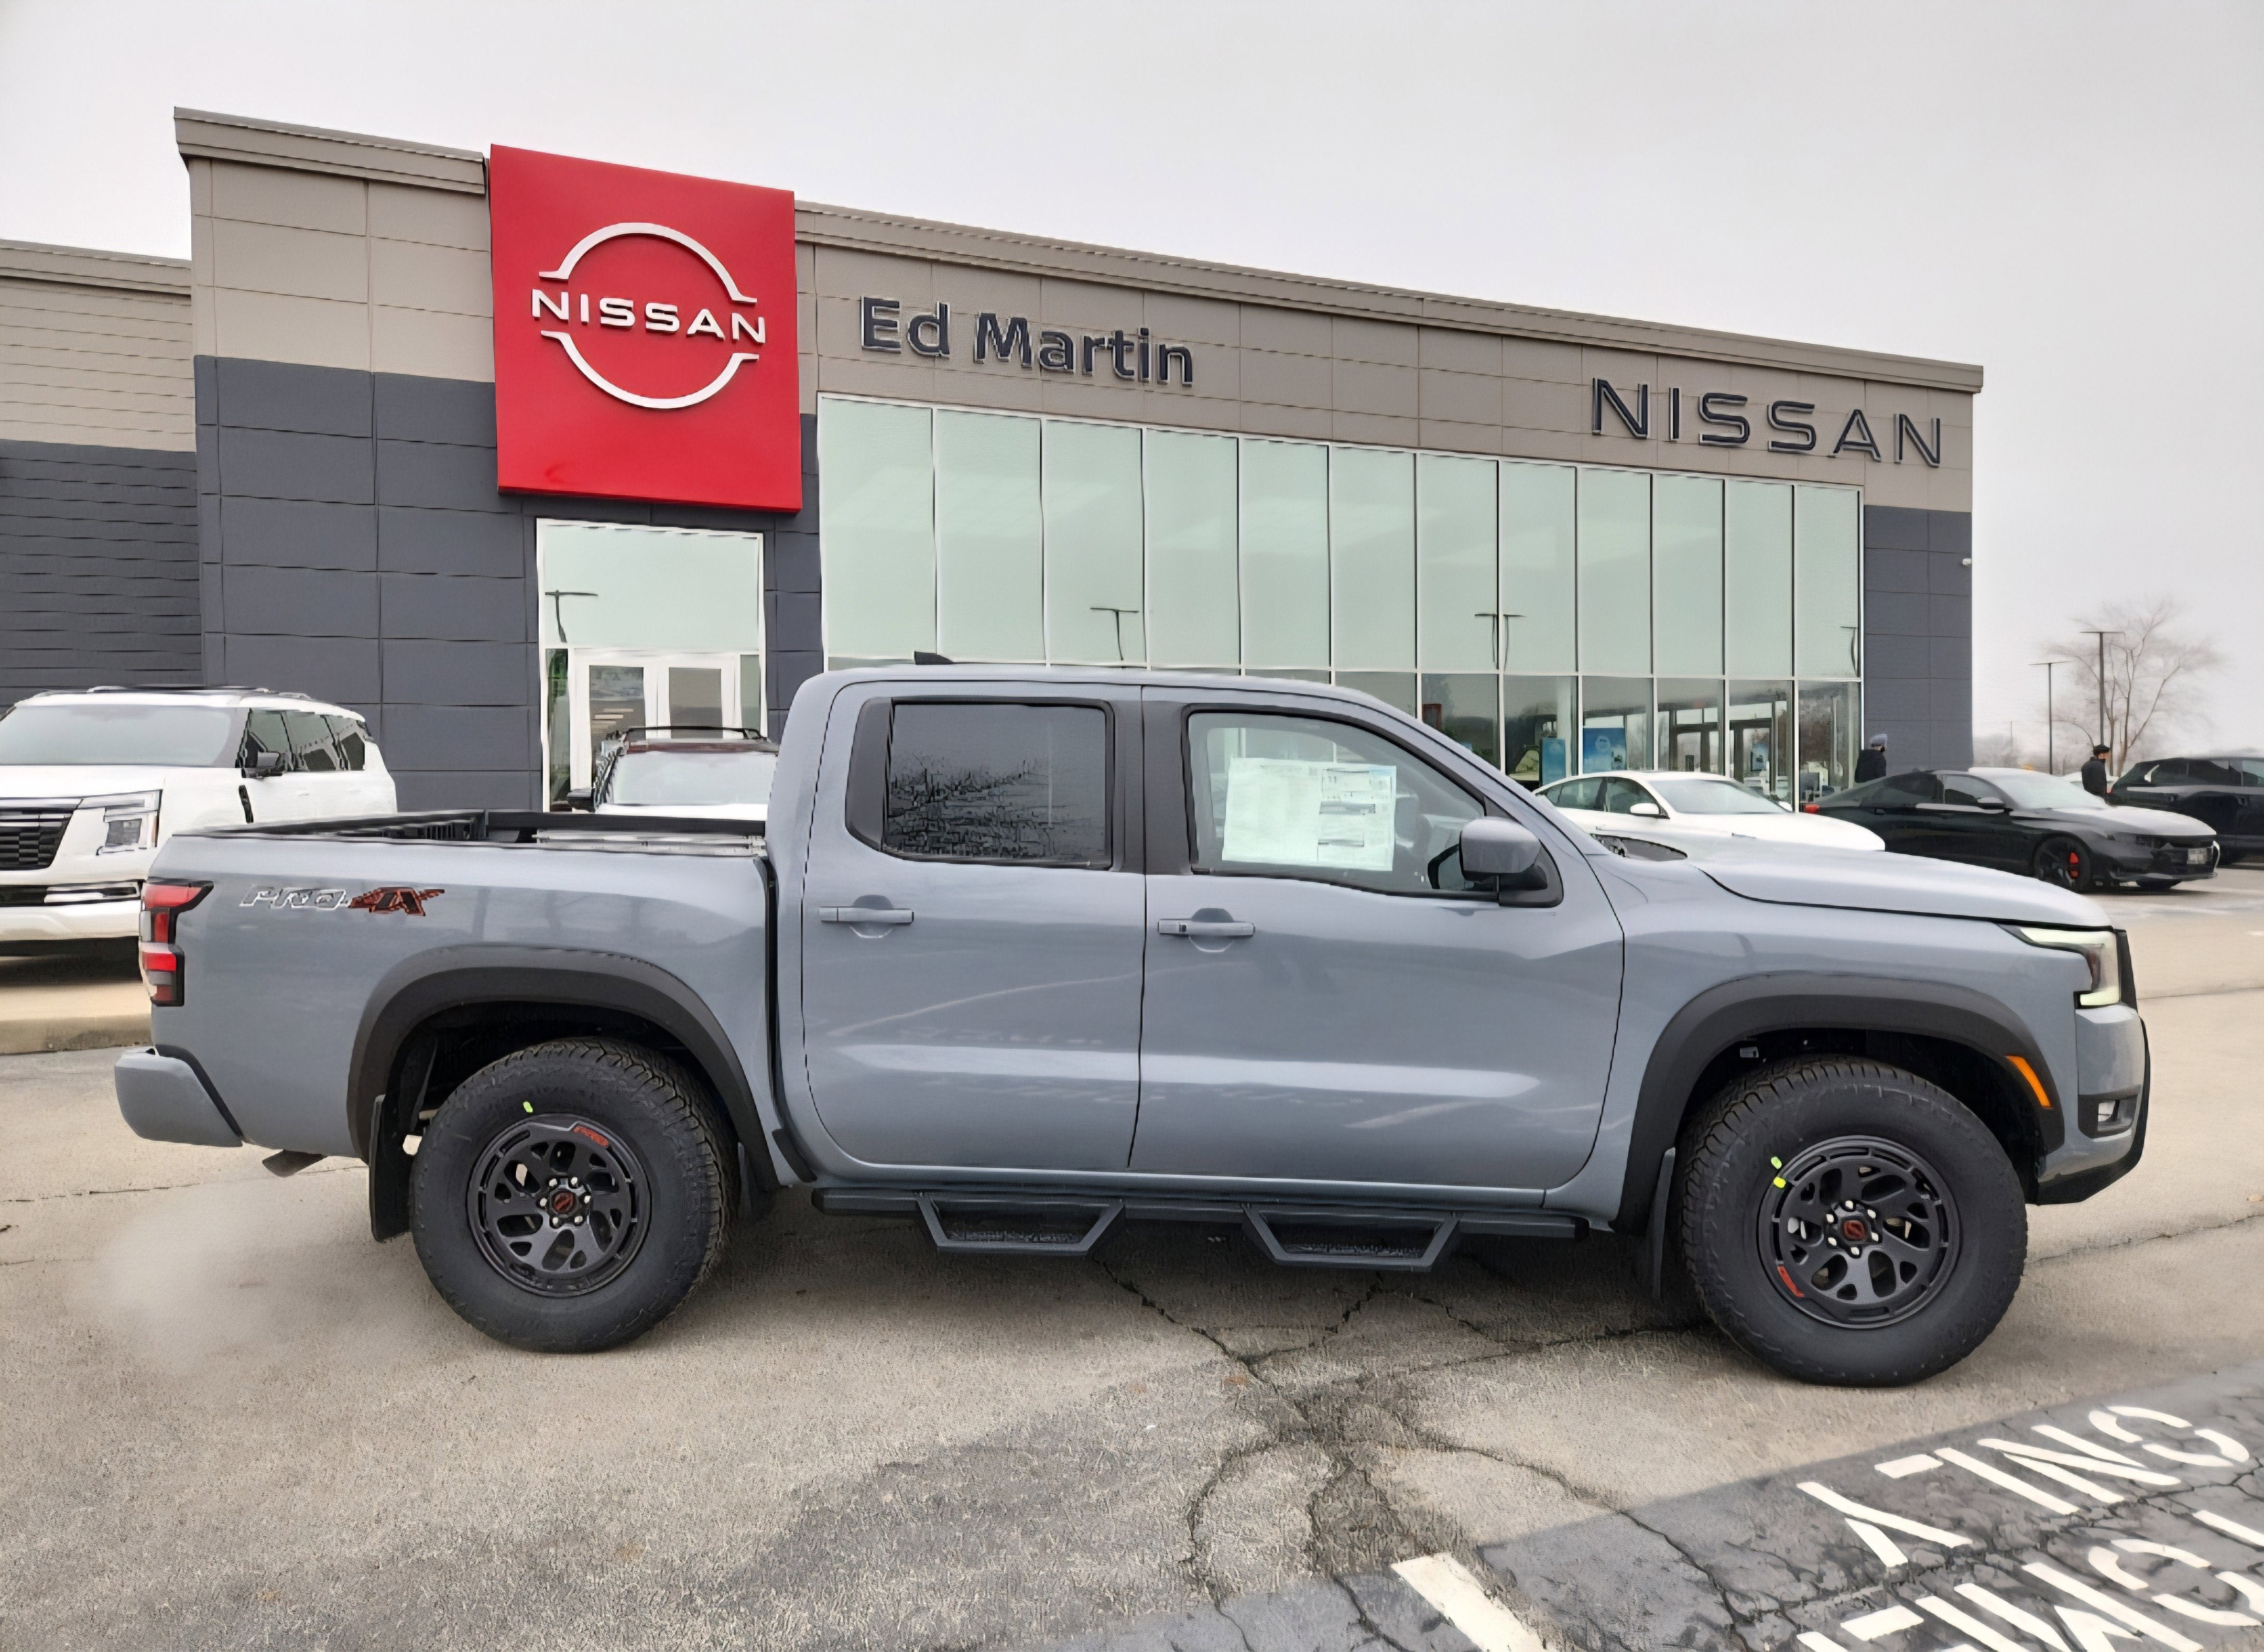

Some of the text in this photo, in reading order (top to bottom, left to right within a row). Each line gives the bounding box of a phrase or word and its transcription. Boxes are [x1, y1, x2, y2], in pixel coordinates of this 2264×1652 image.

[531, 288, 766, 344] NISSAN
[861, 296, 1194, 387] Ed Martin
[1592, 377, 1942, 469] NISSAN
[1797, 1406, 2250, 1568] ONLY
